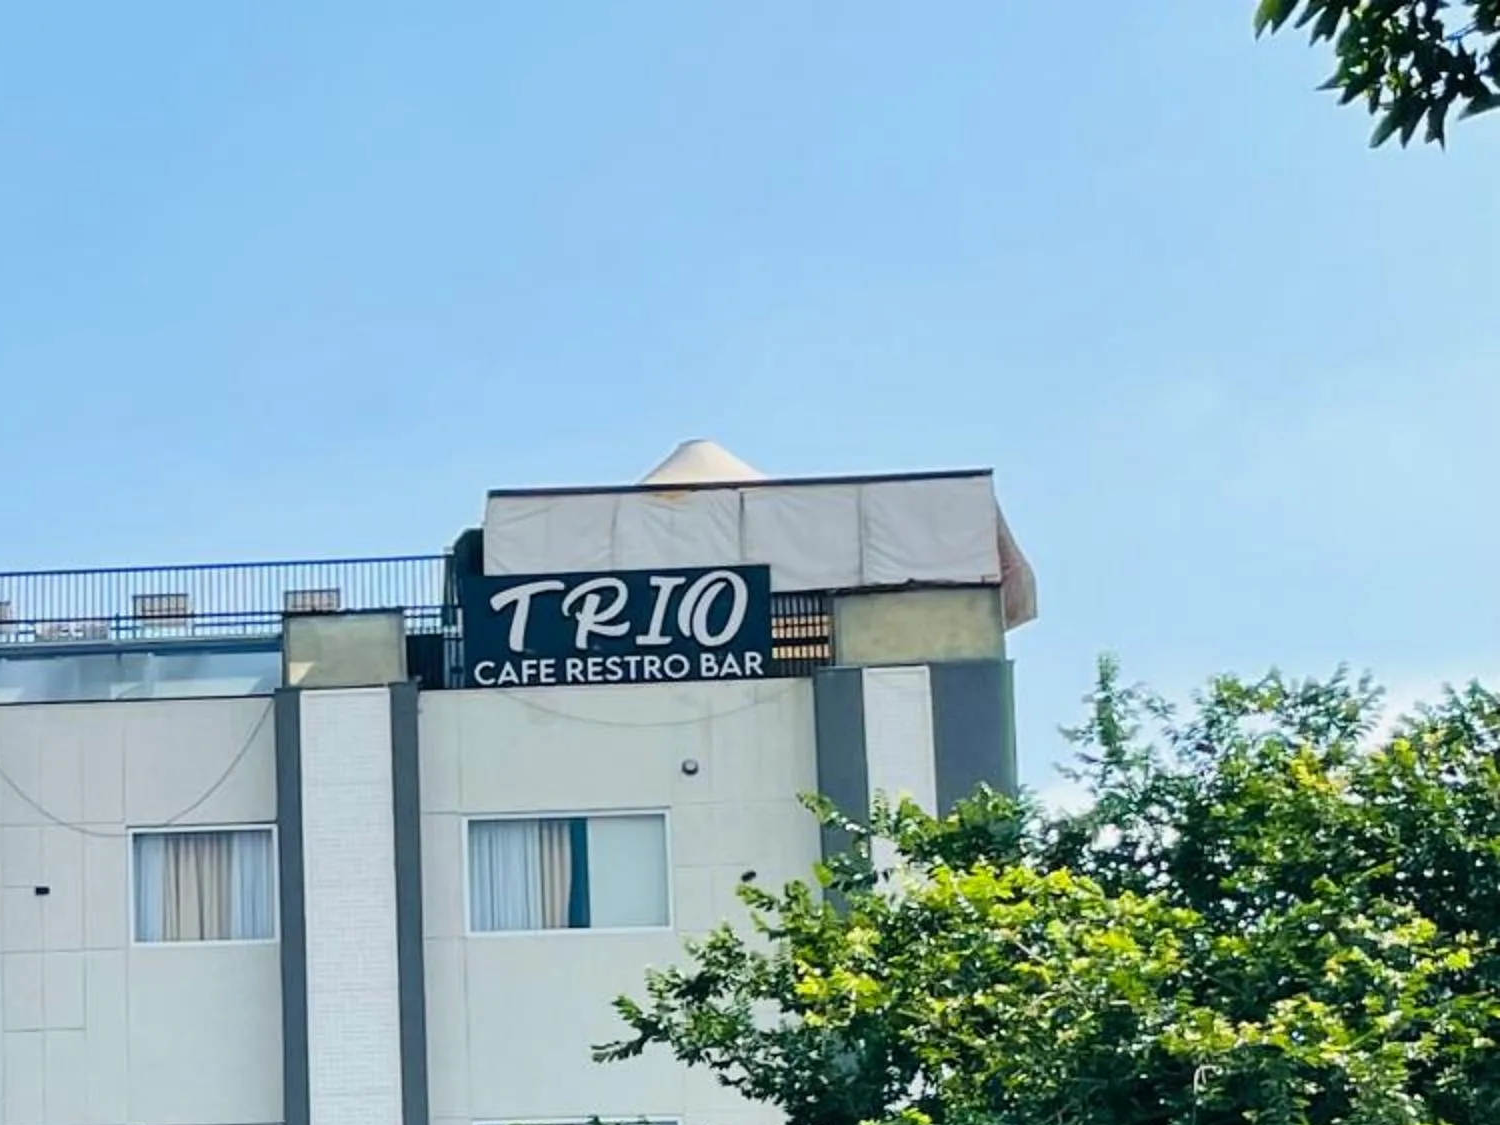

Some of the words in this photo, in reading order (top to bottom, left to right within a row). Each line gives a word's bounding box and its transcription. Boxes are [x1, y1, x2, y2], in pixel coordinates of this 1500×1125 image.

[489, 569, 749, 652] TRIO
[473, 658, 557, 686] CAFE
[565, 653, 691, 683] RESTRO
[699, 651, 765, 678] BAR
